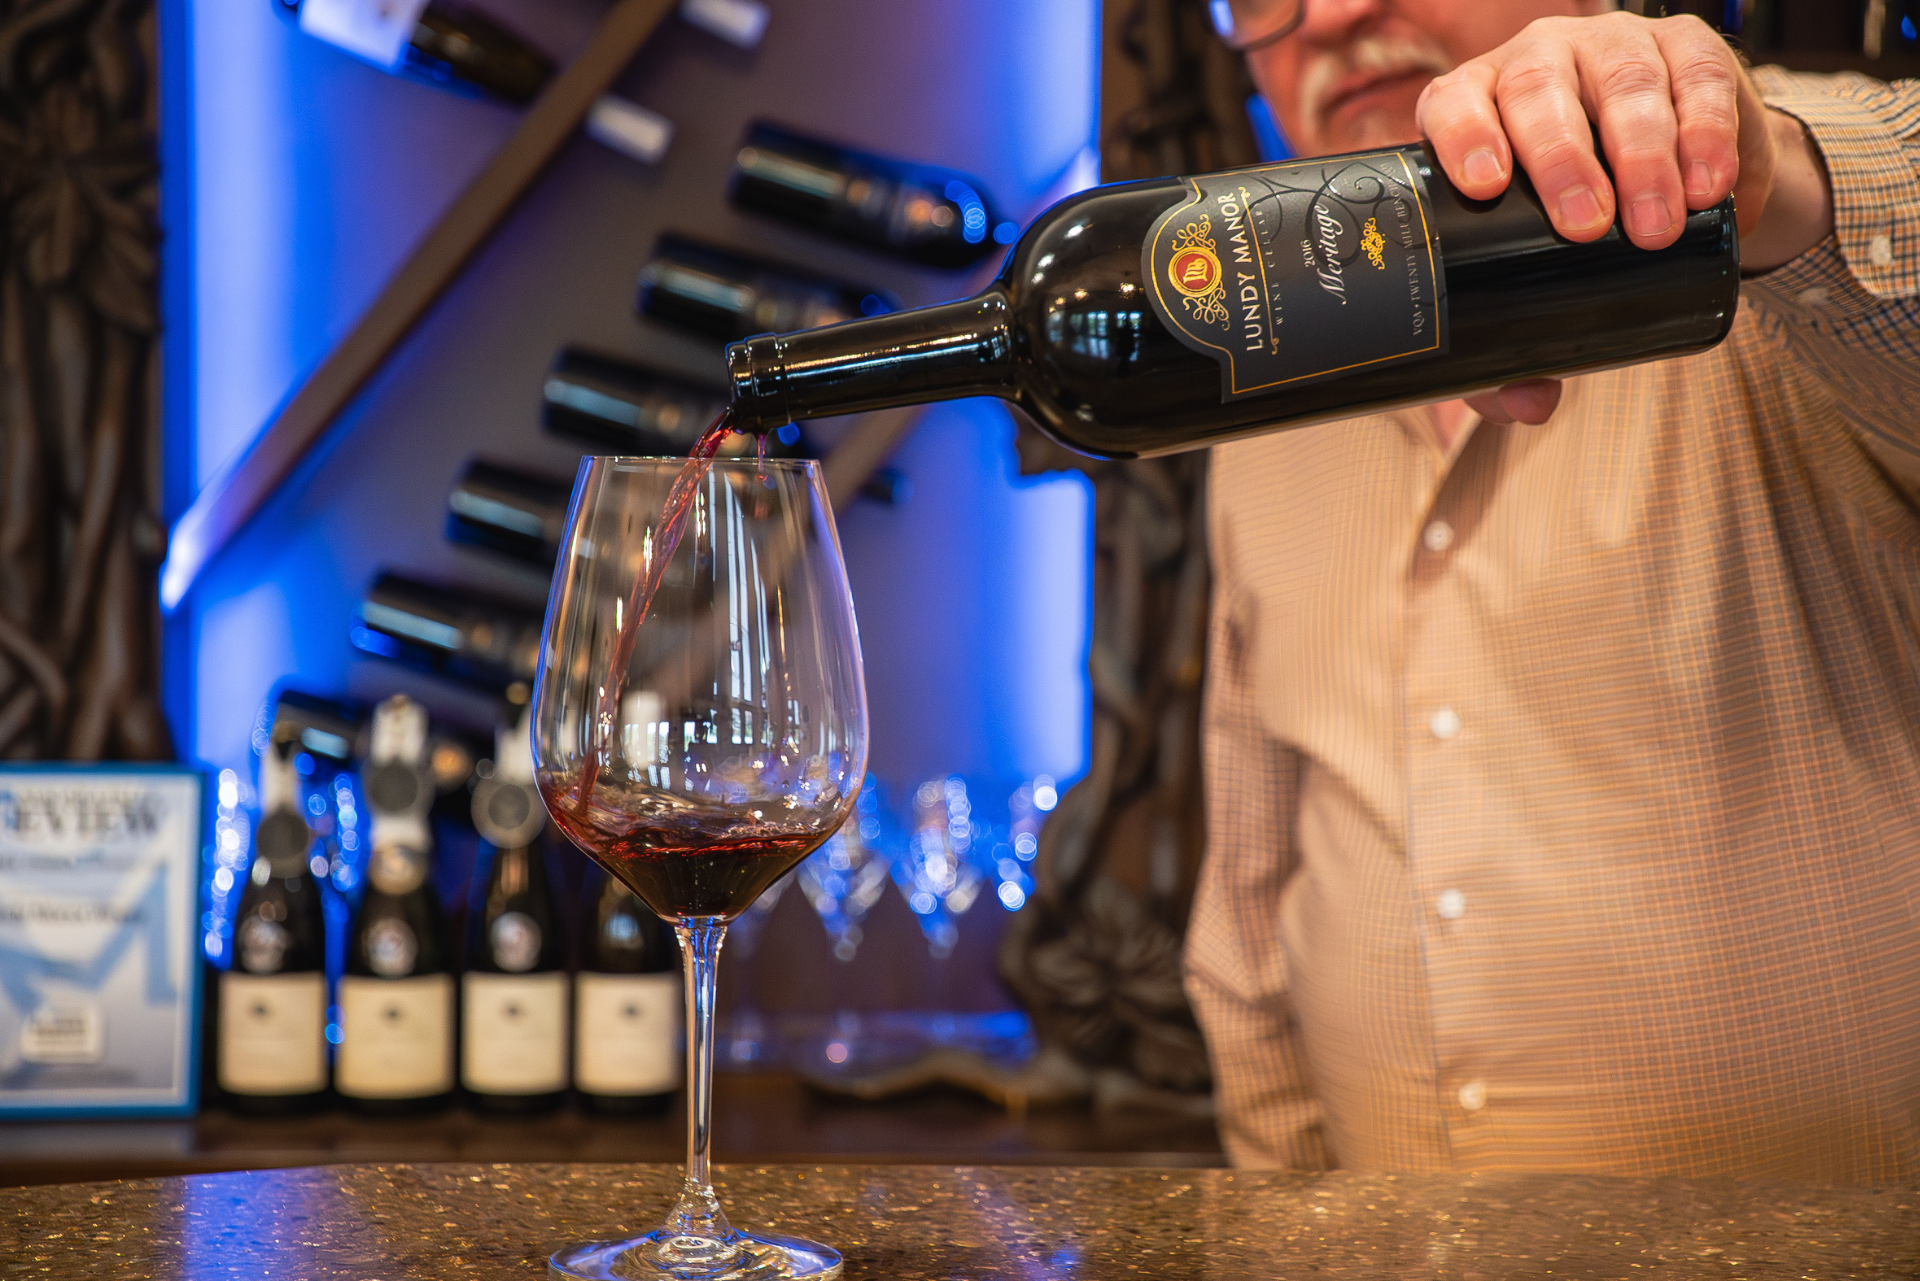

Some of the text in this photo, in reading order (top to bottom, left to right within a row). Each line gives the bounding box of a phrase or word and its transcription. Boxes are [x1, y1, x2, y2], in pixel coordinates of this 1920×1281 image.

[1300, 239, 1316, 268] 2016
[1312, 202, 1347, 305] Meritage
[1400, 224, 1414, 249] MILE
[1217, 192, 1264, 351] LUNDY MANOR
[1406, 255, 1422, 301] TWENTY
[1271, 283, 1284, 325] WINE
[1413, 311, 1426, 336] VQA
